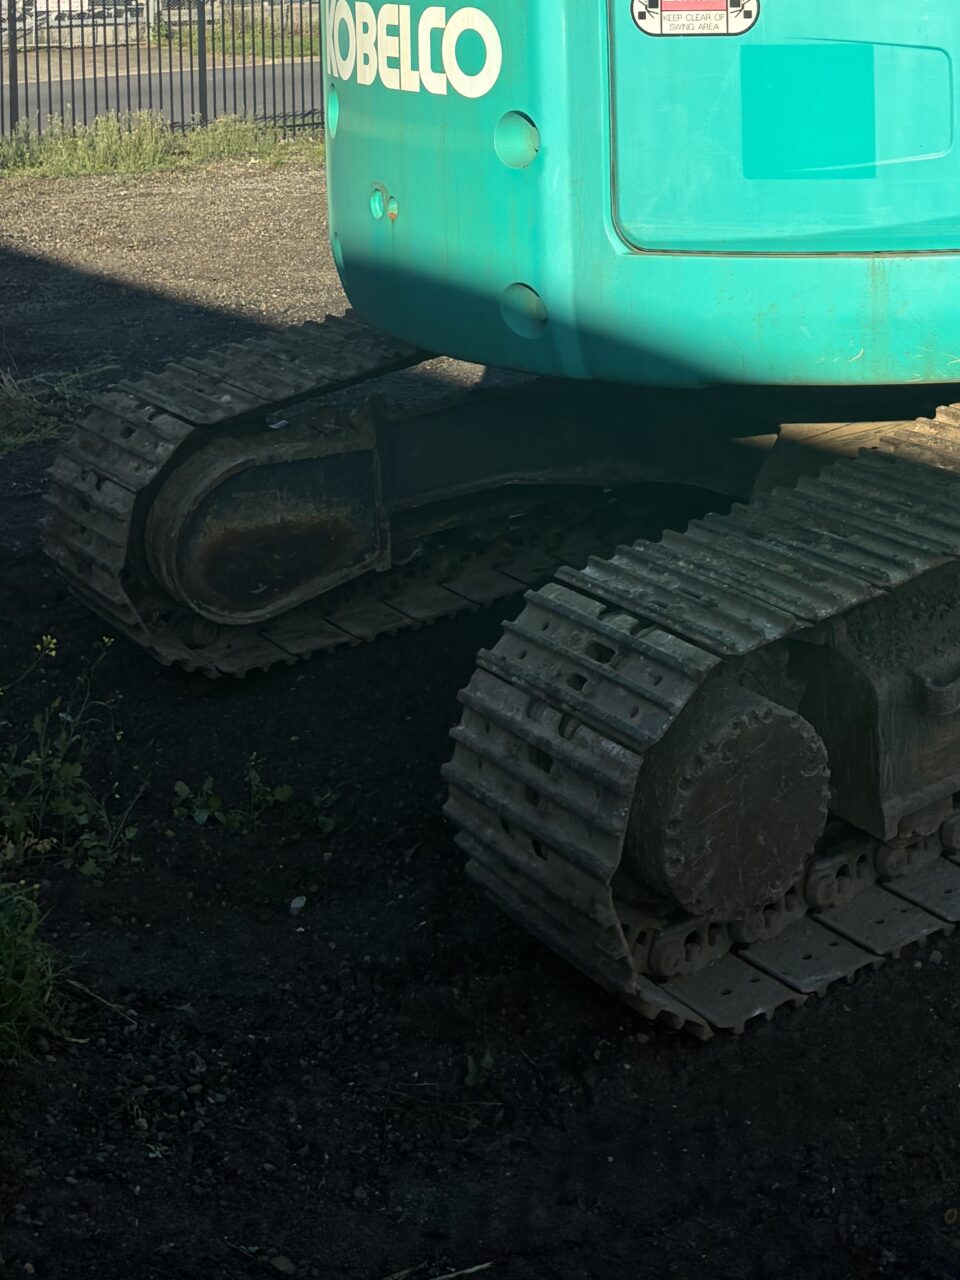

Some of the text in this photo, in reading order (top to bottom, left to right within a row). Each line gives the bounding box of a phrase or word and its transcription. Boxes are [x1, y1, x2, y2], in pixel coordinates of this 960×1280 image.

[663, 13, 725, 22] KEEP CLEAR OF
[669, 23, 719, 31] SWING AREA
